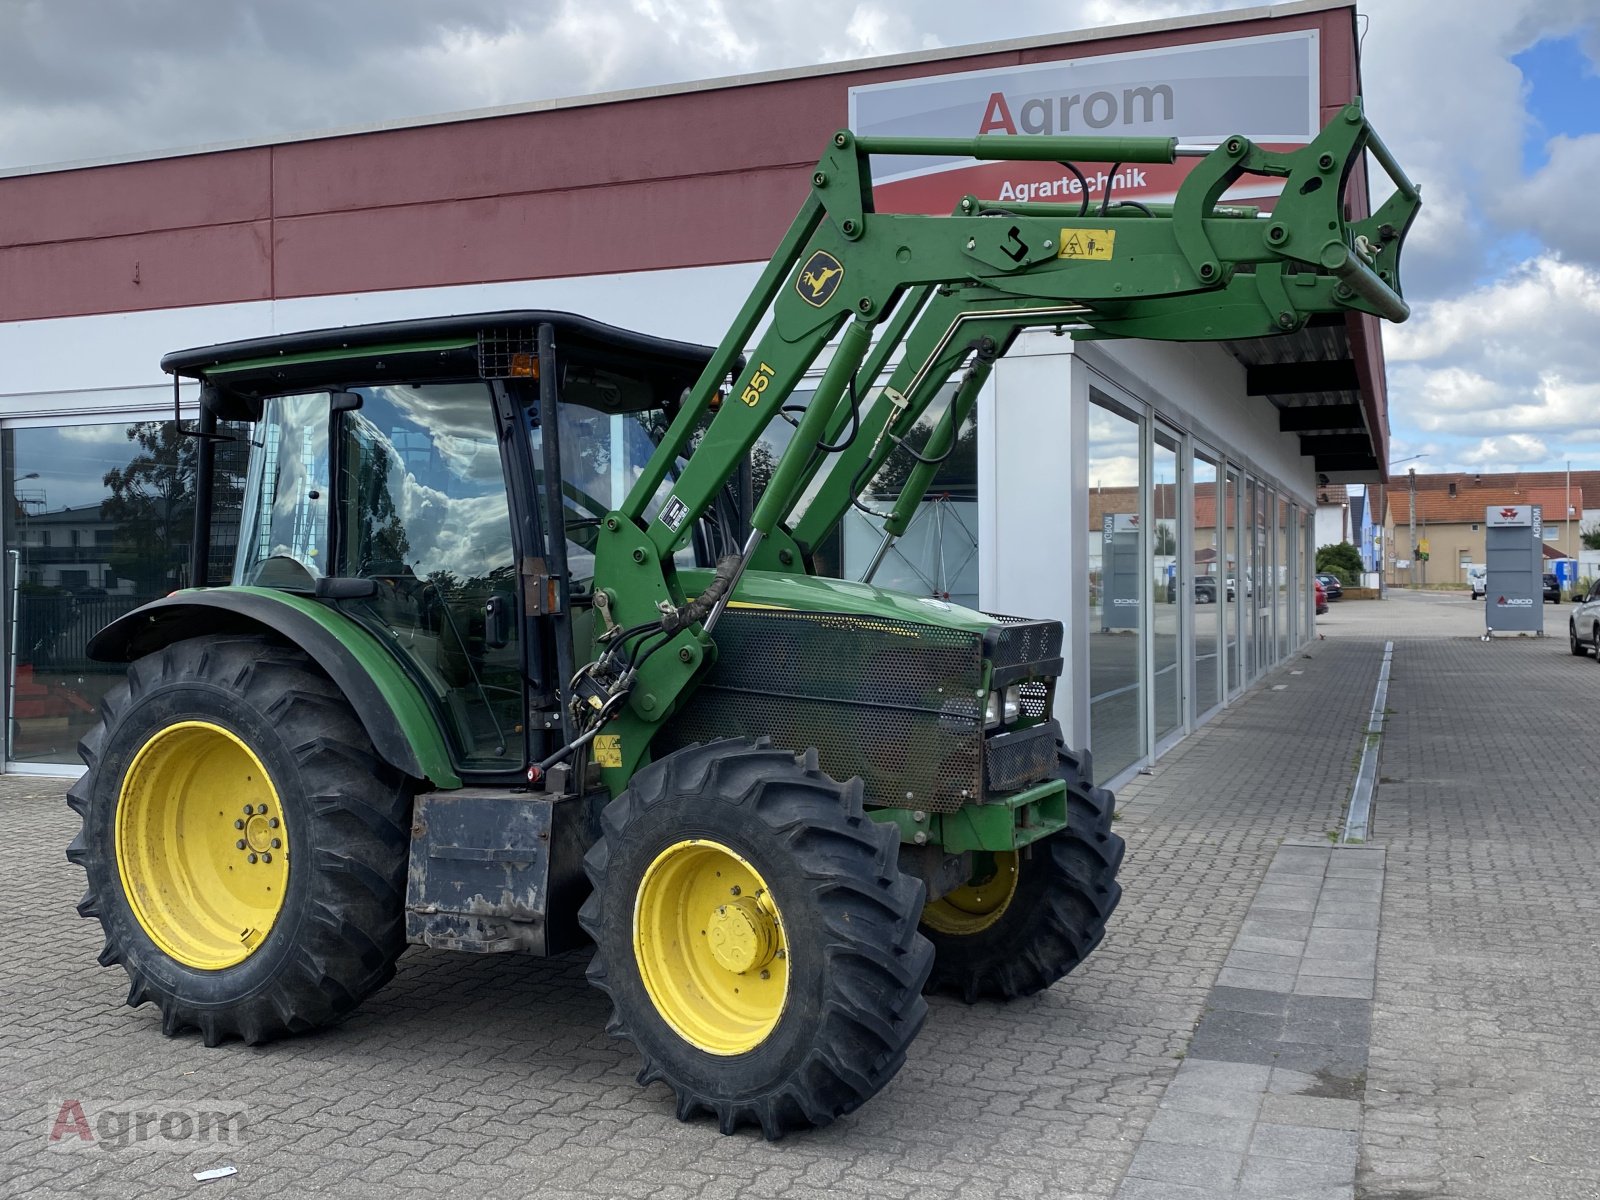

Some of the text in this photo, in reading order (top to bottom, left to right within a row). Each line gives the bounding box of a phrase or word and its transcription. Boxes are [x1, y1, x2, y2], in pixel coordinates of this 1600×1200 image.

[979, 84, 1174, 135] Agrom
[999, 168, 1147, 202] Agrartechnik
[740, 361, 776, 407] 551
[1533, 508, 1541, 538] AGROM
